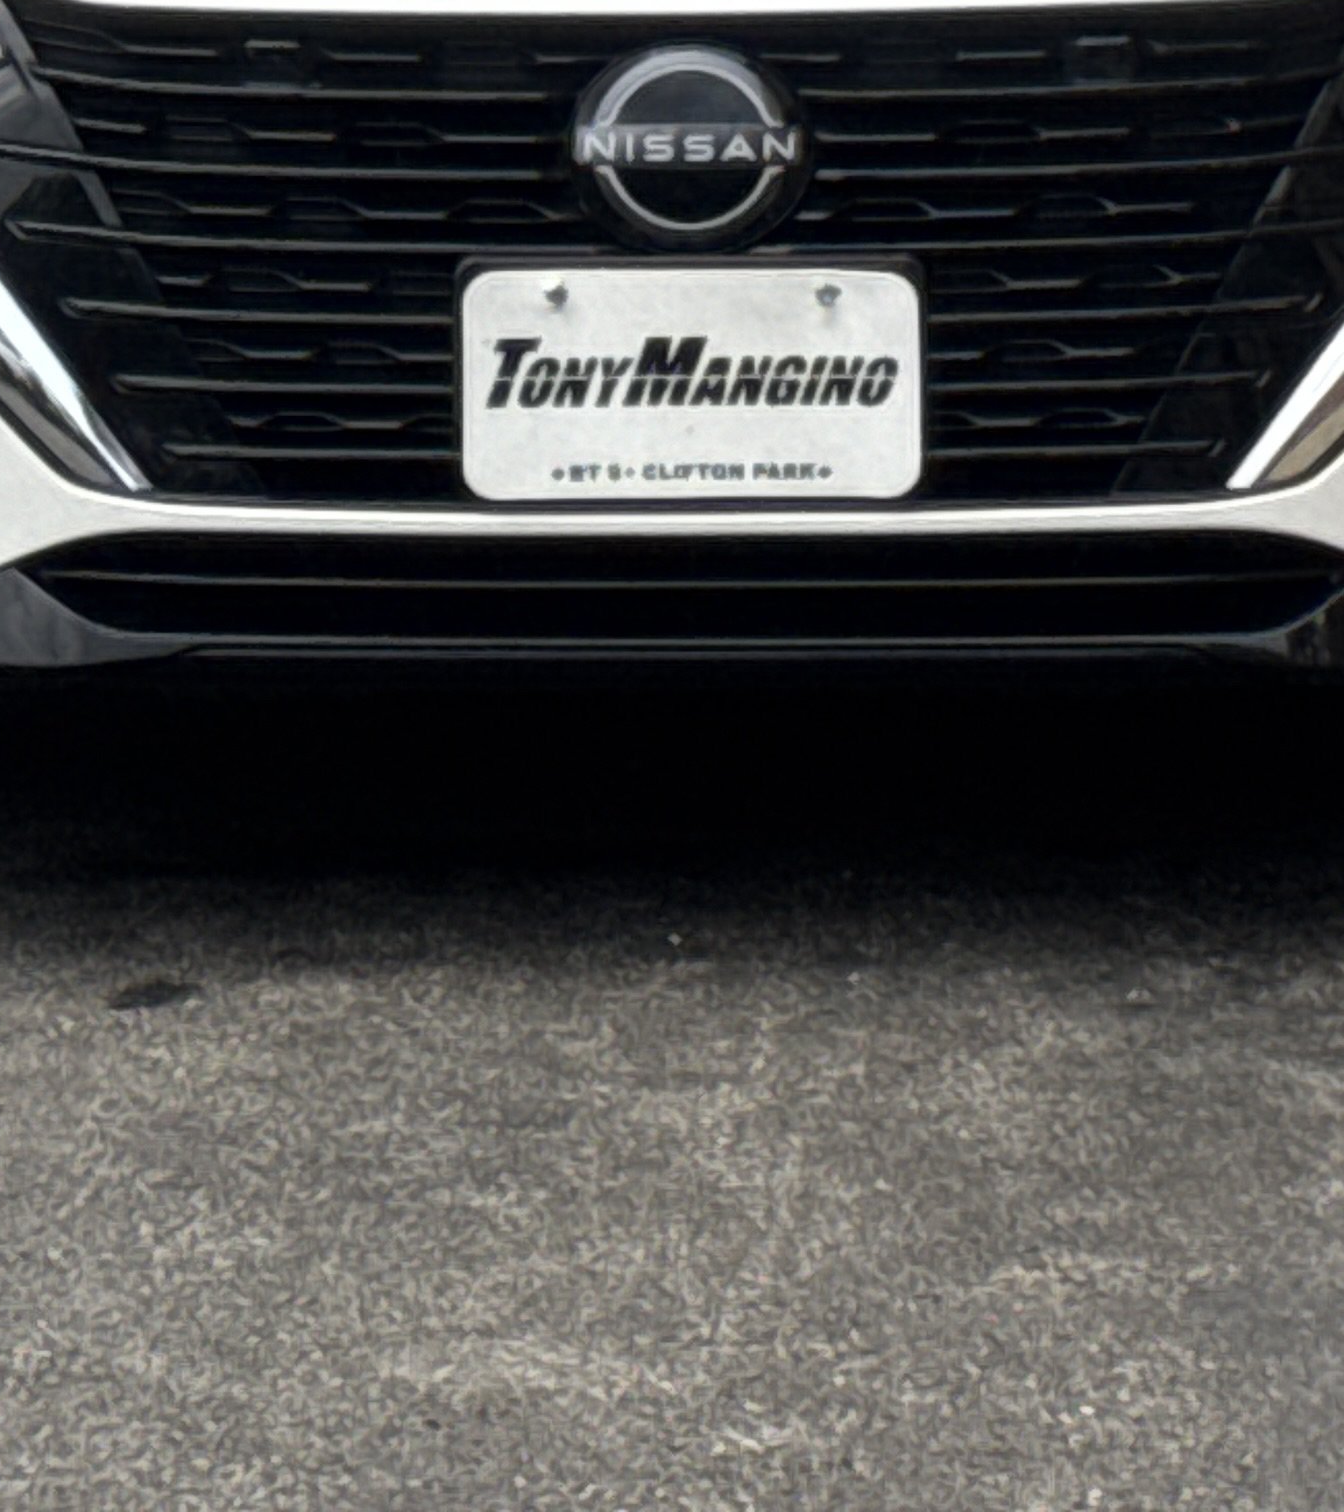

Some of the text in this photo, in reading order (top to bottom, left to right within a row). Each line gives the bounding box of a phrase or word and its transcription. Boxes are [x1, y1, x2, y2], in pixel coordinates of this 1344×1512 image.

[580, 131, 798, 163] NISSAN
[641, 462, 746, 482] CLIFTON
[752, 462, 817, 481] PARK
